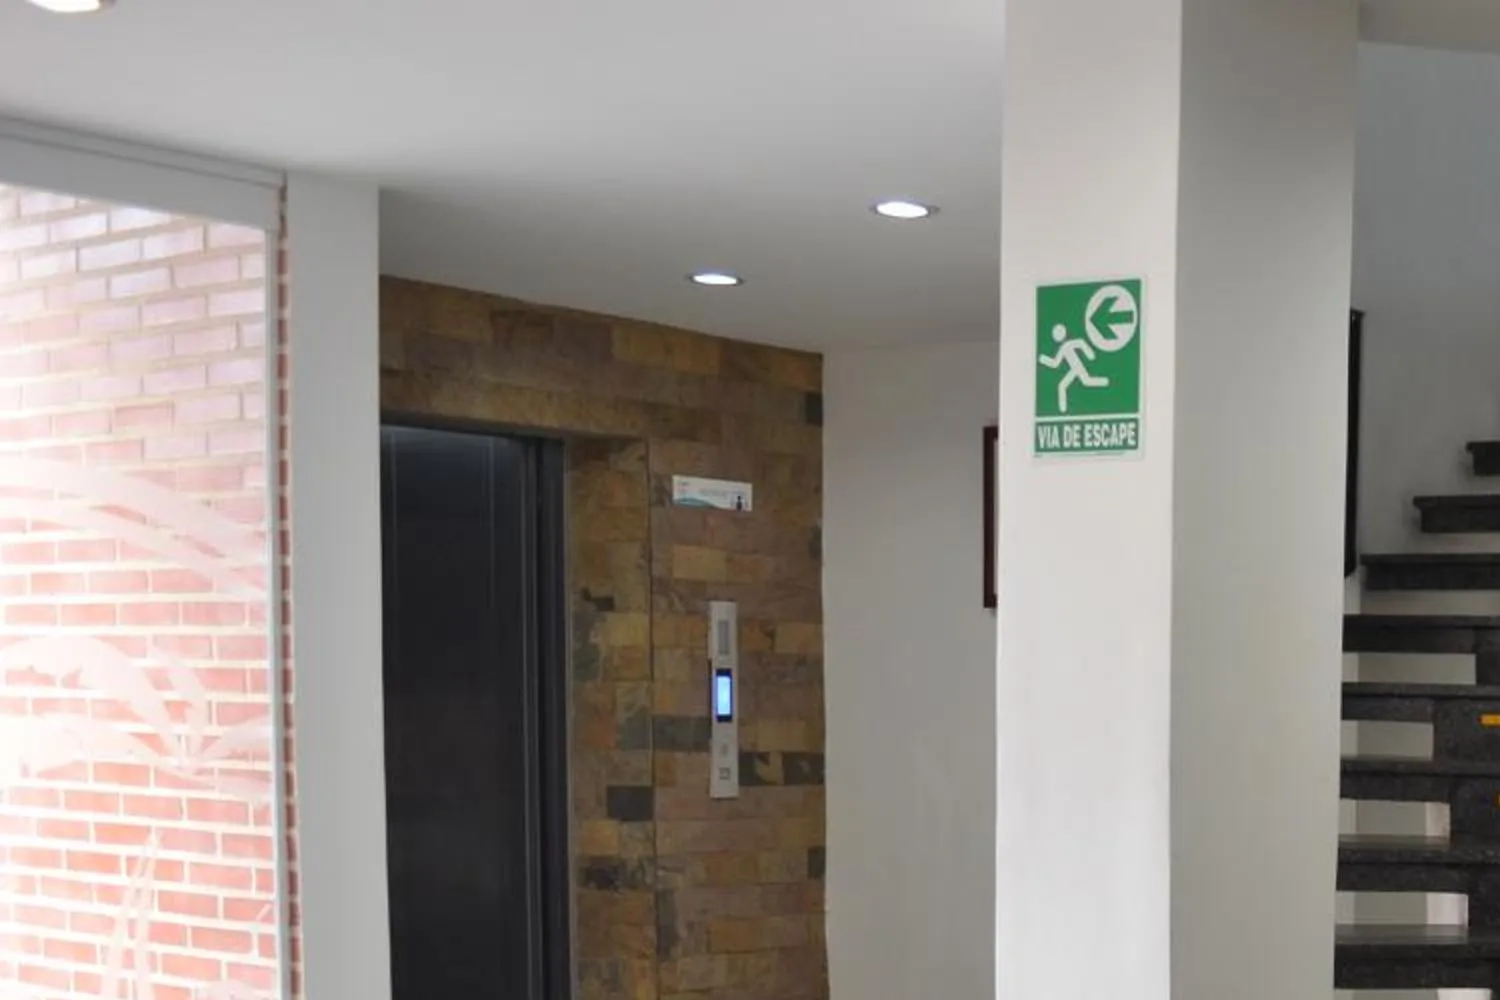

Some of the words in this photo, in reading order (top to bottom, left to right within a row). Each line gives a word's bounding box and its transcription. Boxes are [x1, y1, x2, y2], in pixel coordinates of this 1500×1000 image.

[1037, 424, 1060, 448] VIA
[1063, 424, 1081, 448] DE
[1083, 421, 1137, 448] ESCAPE
